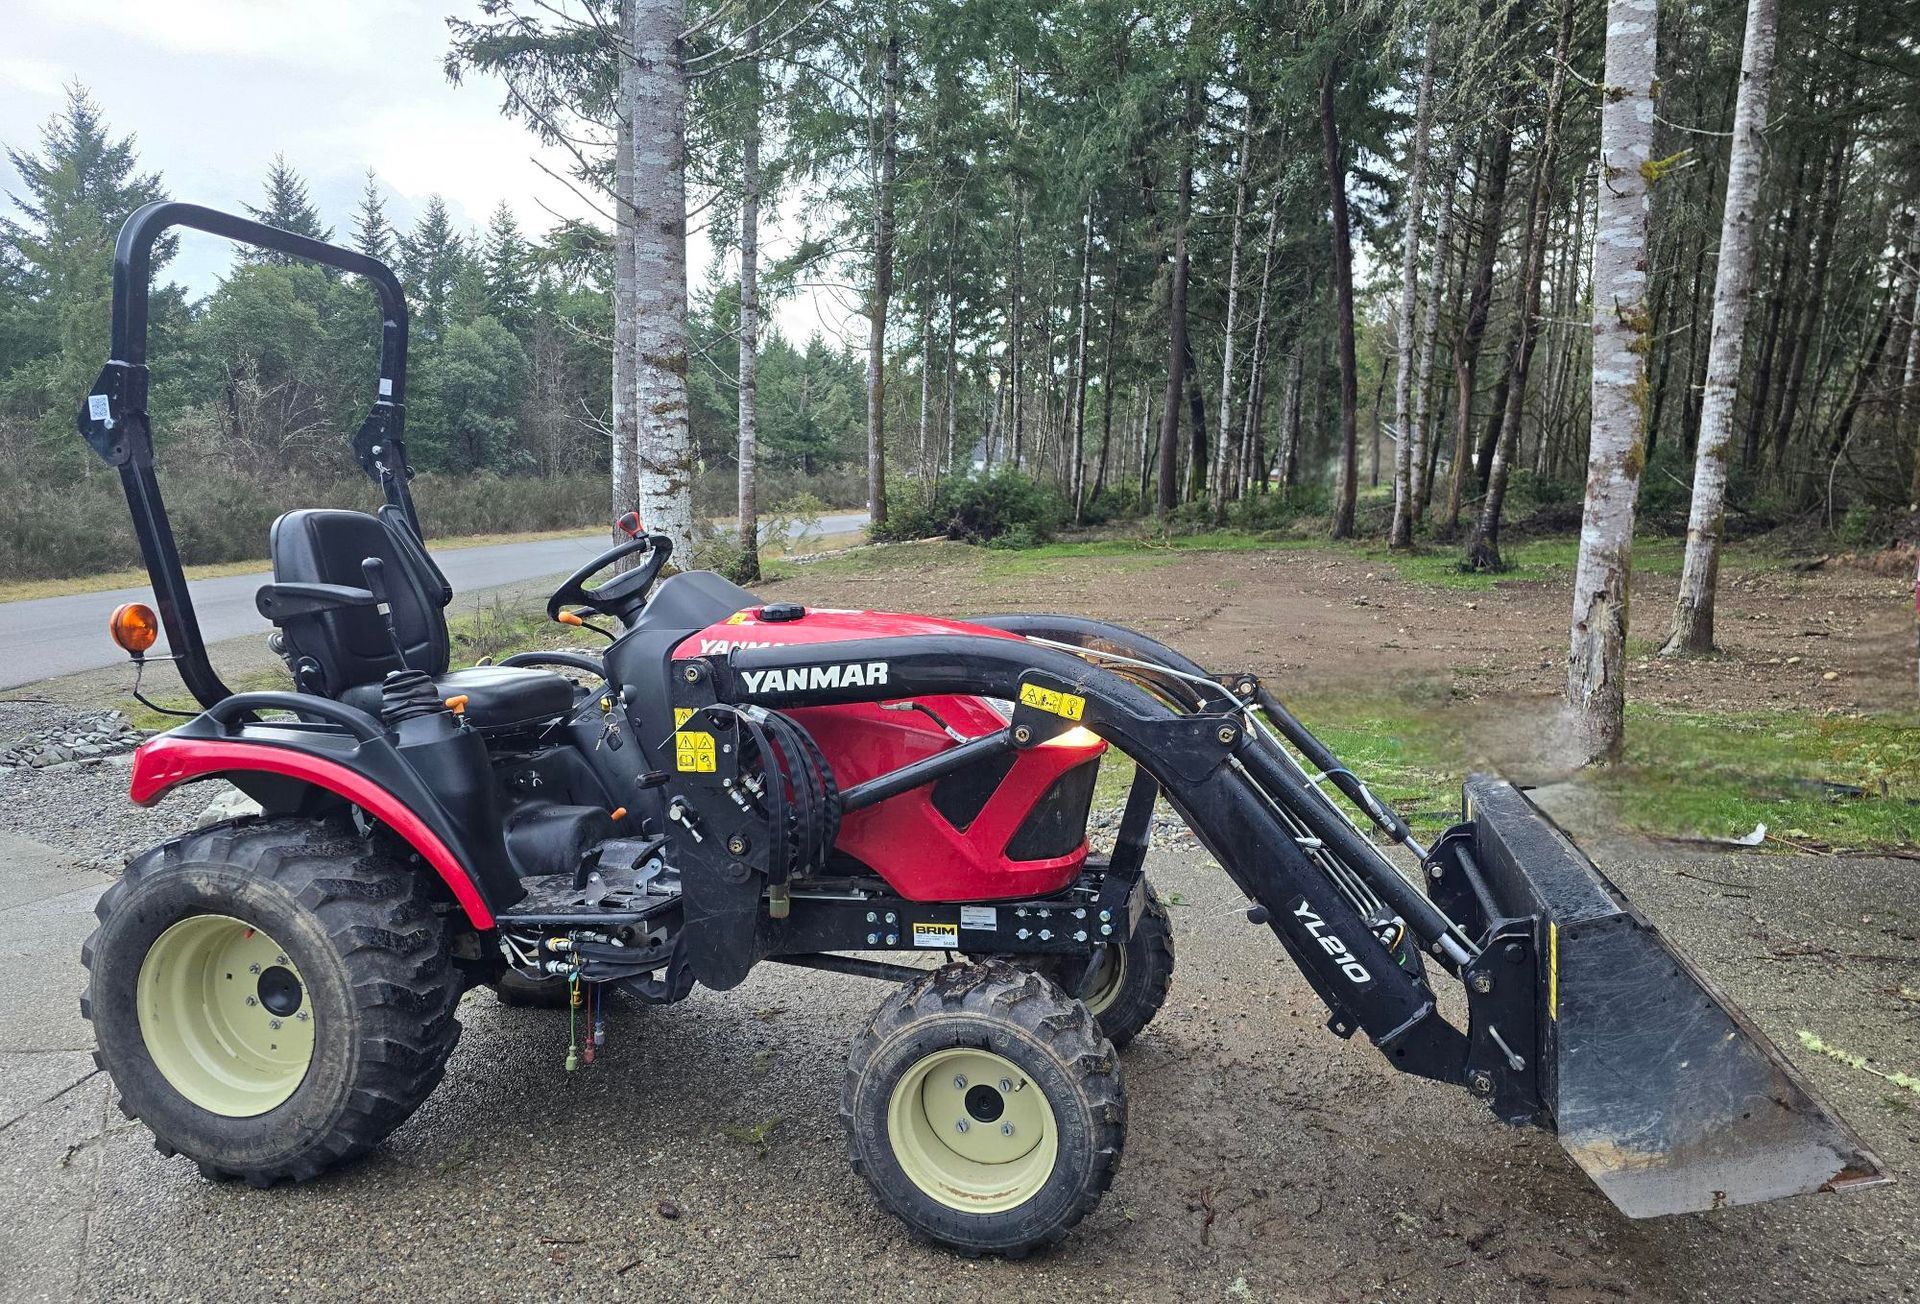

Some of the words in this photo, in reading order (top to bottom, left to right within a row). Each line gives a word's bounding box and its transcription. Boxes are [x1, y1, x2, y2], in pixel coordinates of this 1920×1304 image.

[701, 640, 797, 655] YAN
[741, 662, 888, 694] YANMAR
[915, 926, 955, 936] BRIM
[1293, 900, 1371, 983] YL210
